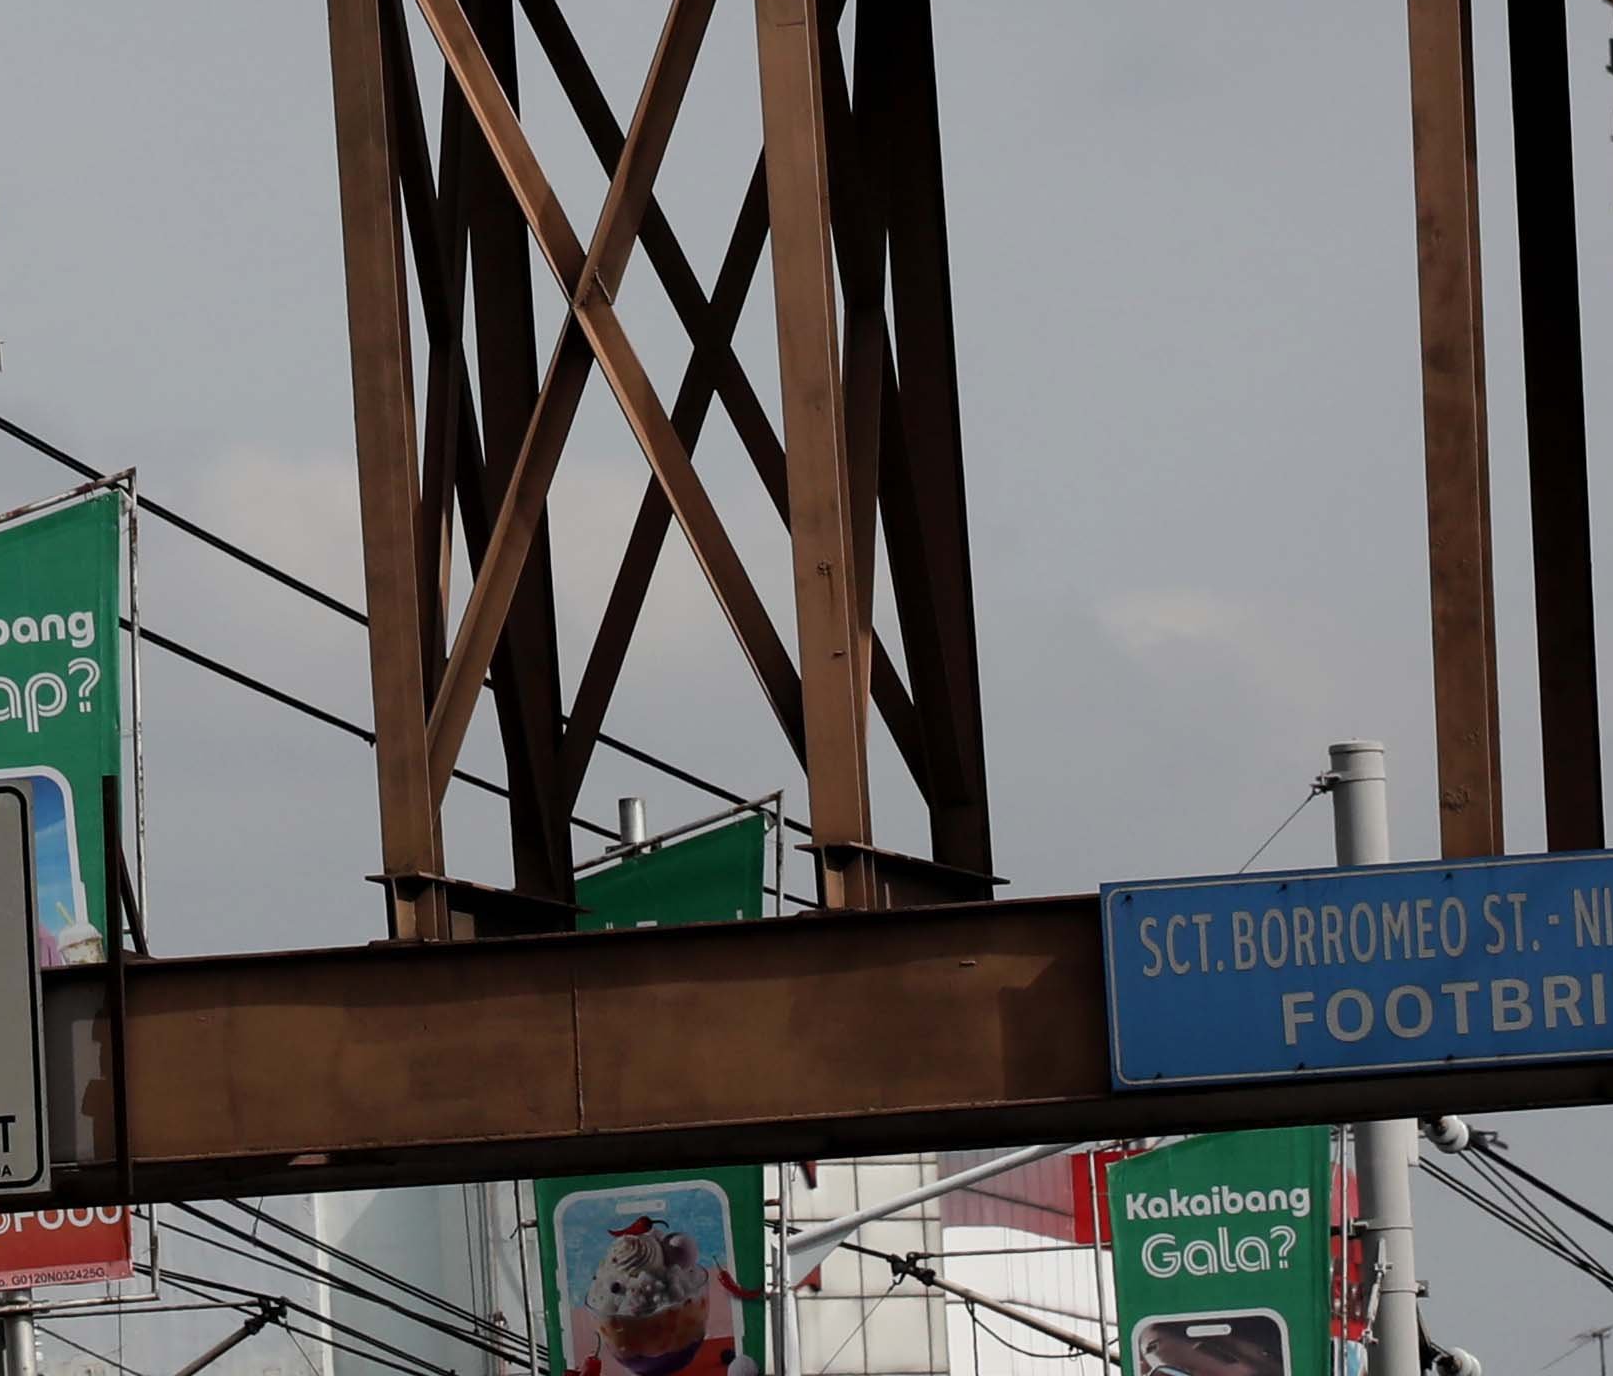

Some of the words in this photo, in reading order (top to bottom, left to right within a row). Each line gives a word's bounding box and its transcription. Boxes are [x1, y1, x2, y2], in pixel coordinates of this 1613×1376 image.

[1140, 913, 1224, 977] SCT.
[1232, 896, 1468, 971] BORROMEO
[1483, 892, 1540, 954] ST.
[1125, 1185, 1312, 1221] Kakaibang
[1141, 1225, 1297, 1279] Gala?
